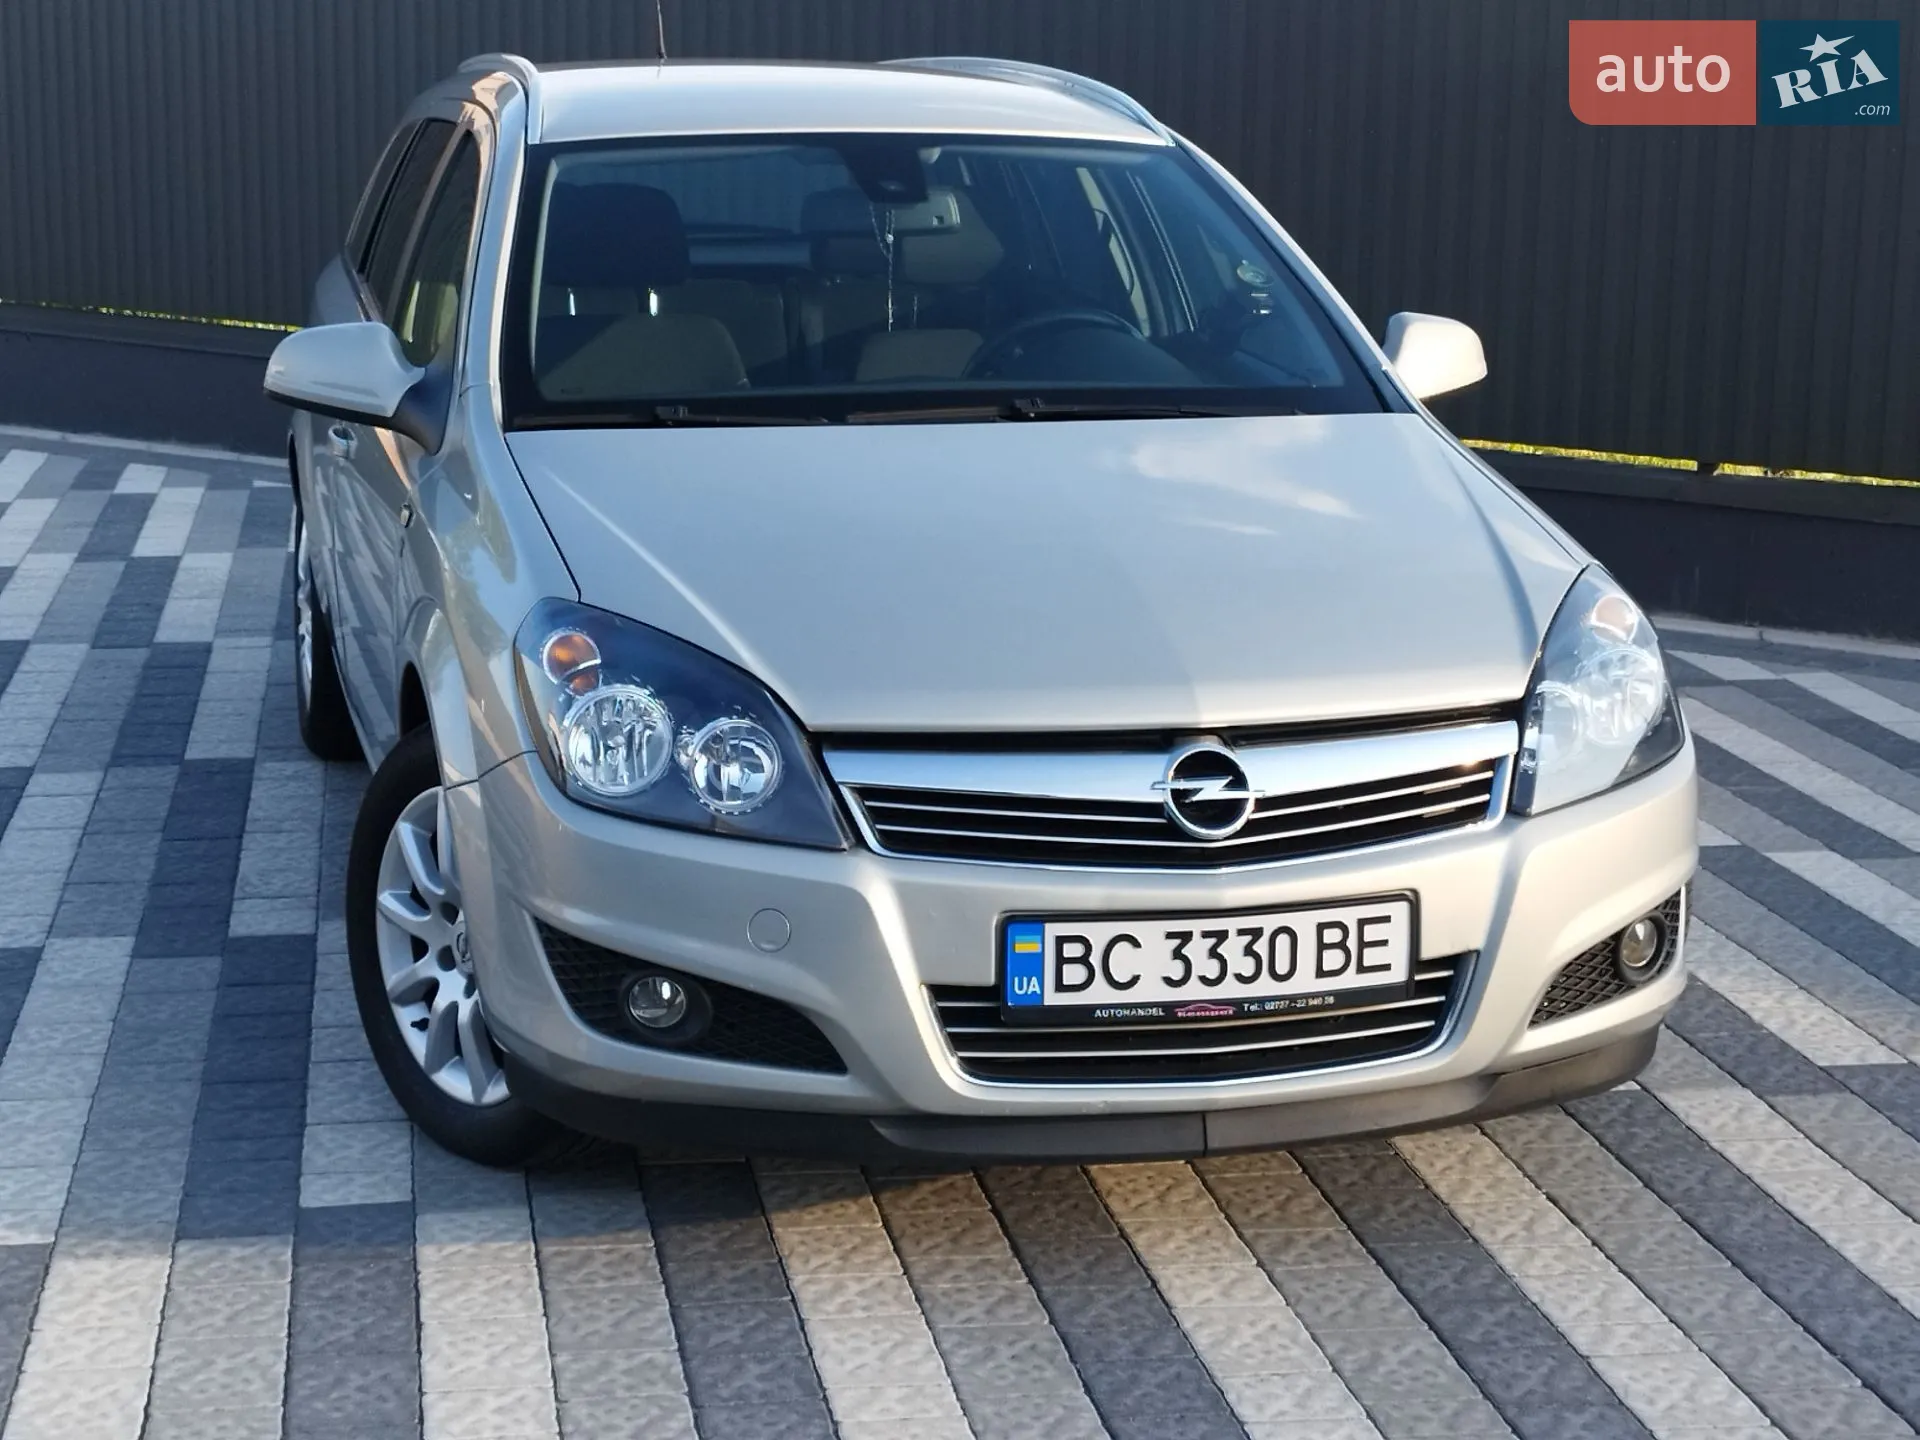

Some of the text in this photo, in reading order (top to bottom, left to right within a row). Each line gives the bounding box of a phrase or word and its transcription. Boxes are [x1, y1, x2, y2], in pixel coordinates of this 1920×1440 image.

[1053, 915, 1392, 993] BC 3330 BE
[1014, 976, 1041, 994] UA
[1094, 1007, 1165, 1018] AUTOHANDEL
